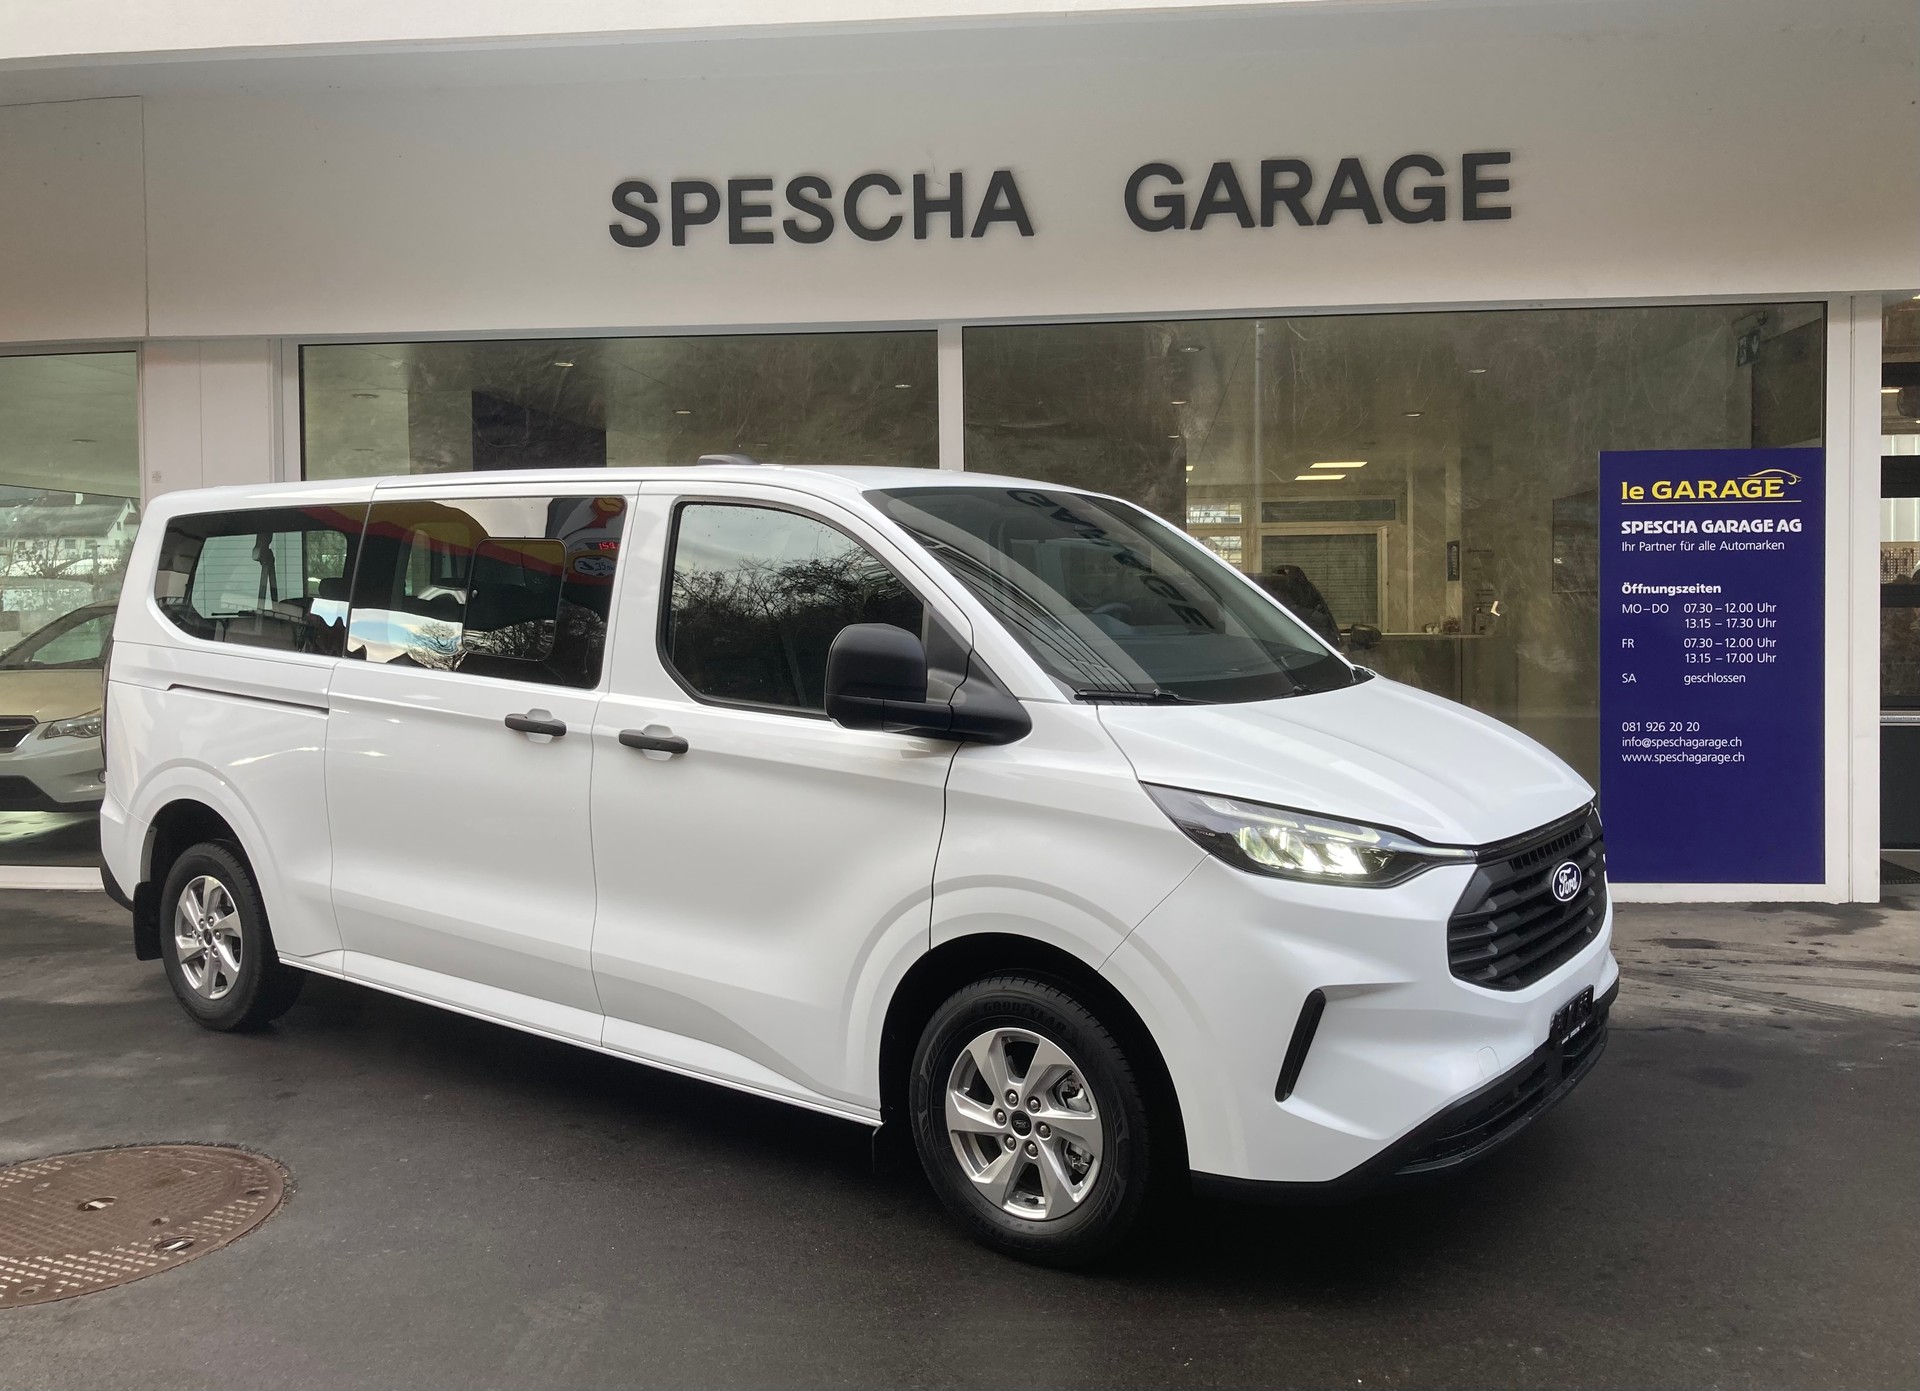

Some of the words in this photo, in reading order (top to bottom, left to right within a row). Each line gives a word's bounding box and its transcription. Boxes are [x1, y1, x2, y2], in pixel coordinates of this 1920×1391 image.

[609, 171, 1034, 248] SPESCHA
[1124, 152, 1512, 233] GARAGE
[1622, 482, 1644, 499] le
[1652, 480, 1784, 499] GARAGE
[1620, 519, 1699, 535] SPESCHA
[1700, 518, 1774, 534] GARAGE
[1775, 518, 1803, 533] AG
[1621, 541, 1636, 552] Ihr
[1639, 541, 1677, 552] Partner
[1679, 540, 1696, 552] für
[1698, 540, 1717, 551] alle
[1719, 539, 1785, 551] Automarken
[1621, 581, 1722, 597] Öffnungszeiten
[1683, 602, 1713, 614] 07.30
[1724, 602, 1754, 614] 12.00
[1757, 601, 1777, 613] Uhr
[1684, 617, 1712, 629] 13.15
[1725, 617, 1754, 629] 17.30
[1757, 617, 1777, 629] Uhr
[1621, 638, 1635, 649] FR
[1683, 637, 1713, 649] 07.30
[1724, 637, 1754, 648] 12.00
[1756, 636, 1777, 648] Uhr
[1684, 652, 1712, 664] 13.15
[1725, 652, 1754, 664] 17.00
[1757, 652, 1777, 664] Uhr
[1621, 672, 1637, 684] SA
[1683, 672, 1746, 686] geschlossen
[1621, 721, 1641, 732] 081
[1645, 721, 1666, 732] 926
[1668, 721, 1683, 732] 20
[1686, 721, 1700, 732] 20
[1622, 735, 1743, 750] info@speschagarage.ch
[1621, 751, 1745, 765] www.speschagarage.ch
[1558, 867, 1578, 897] Ford
